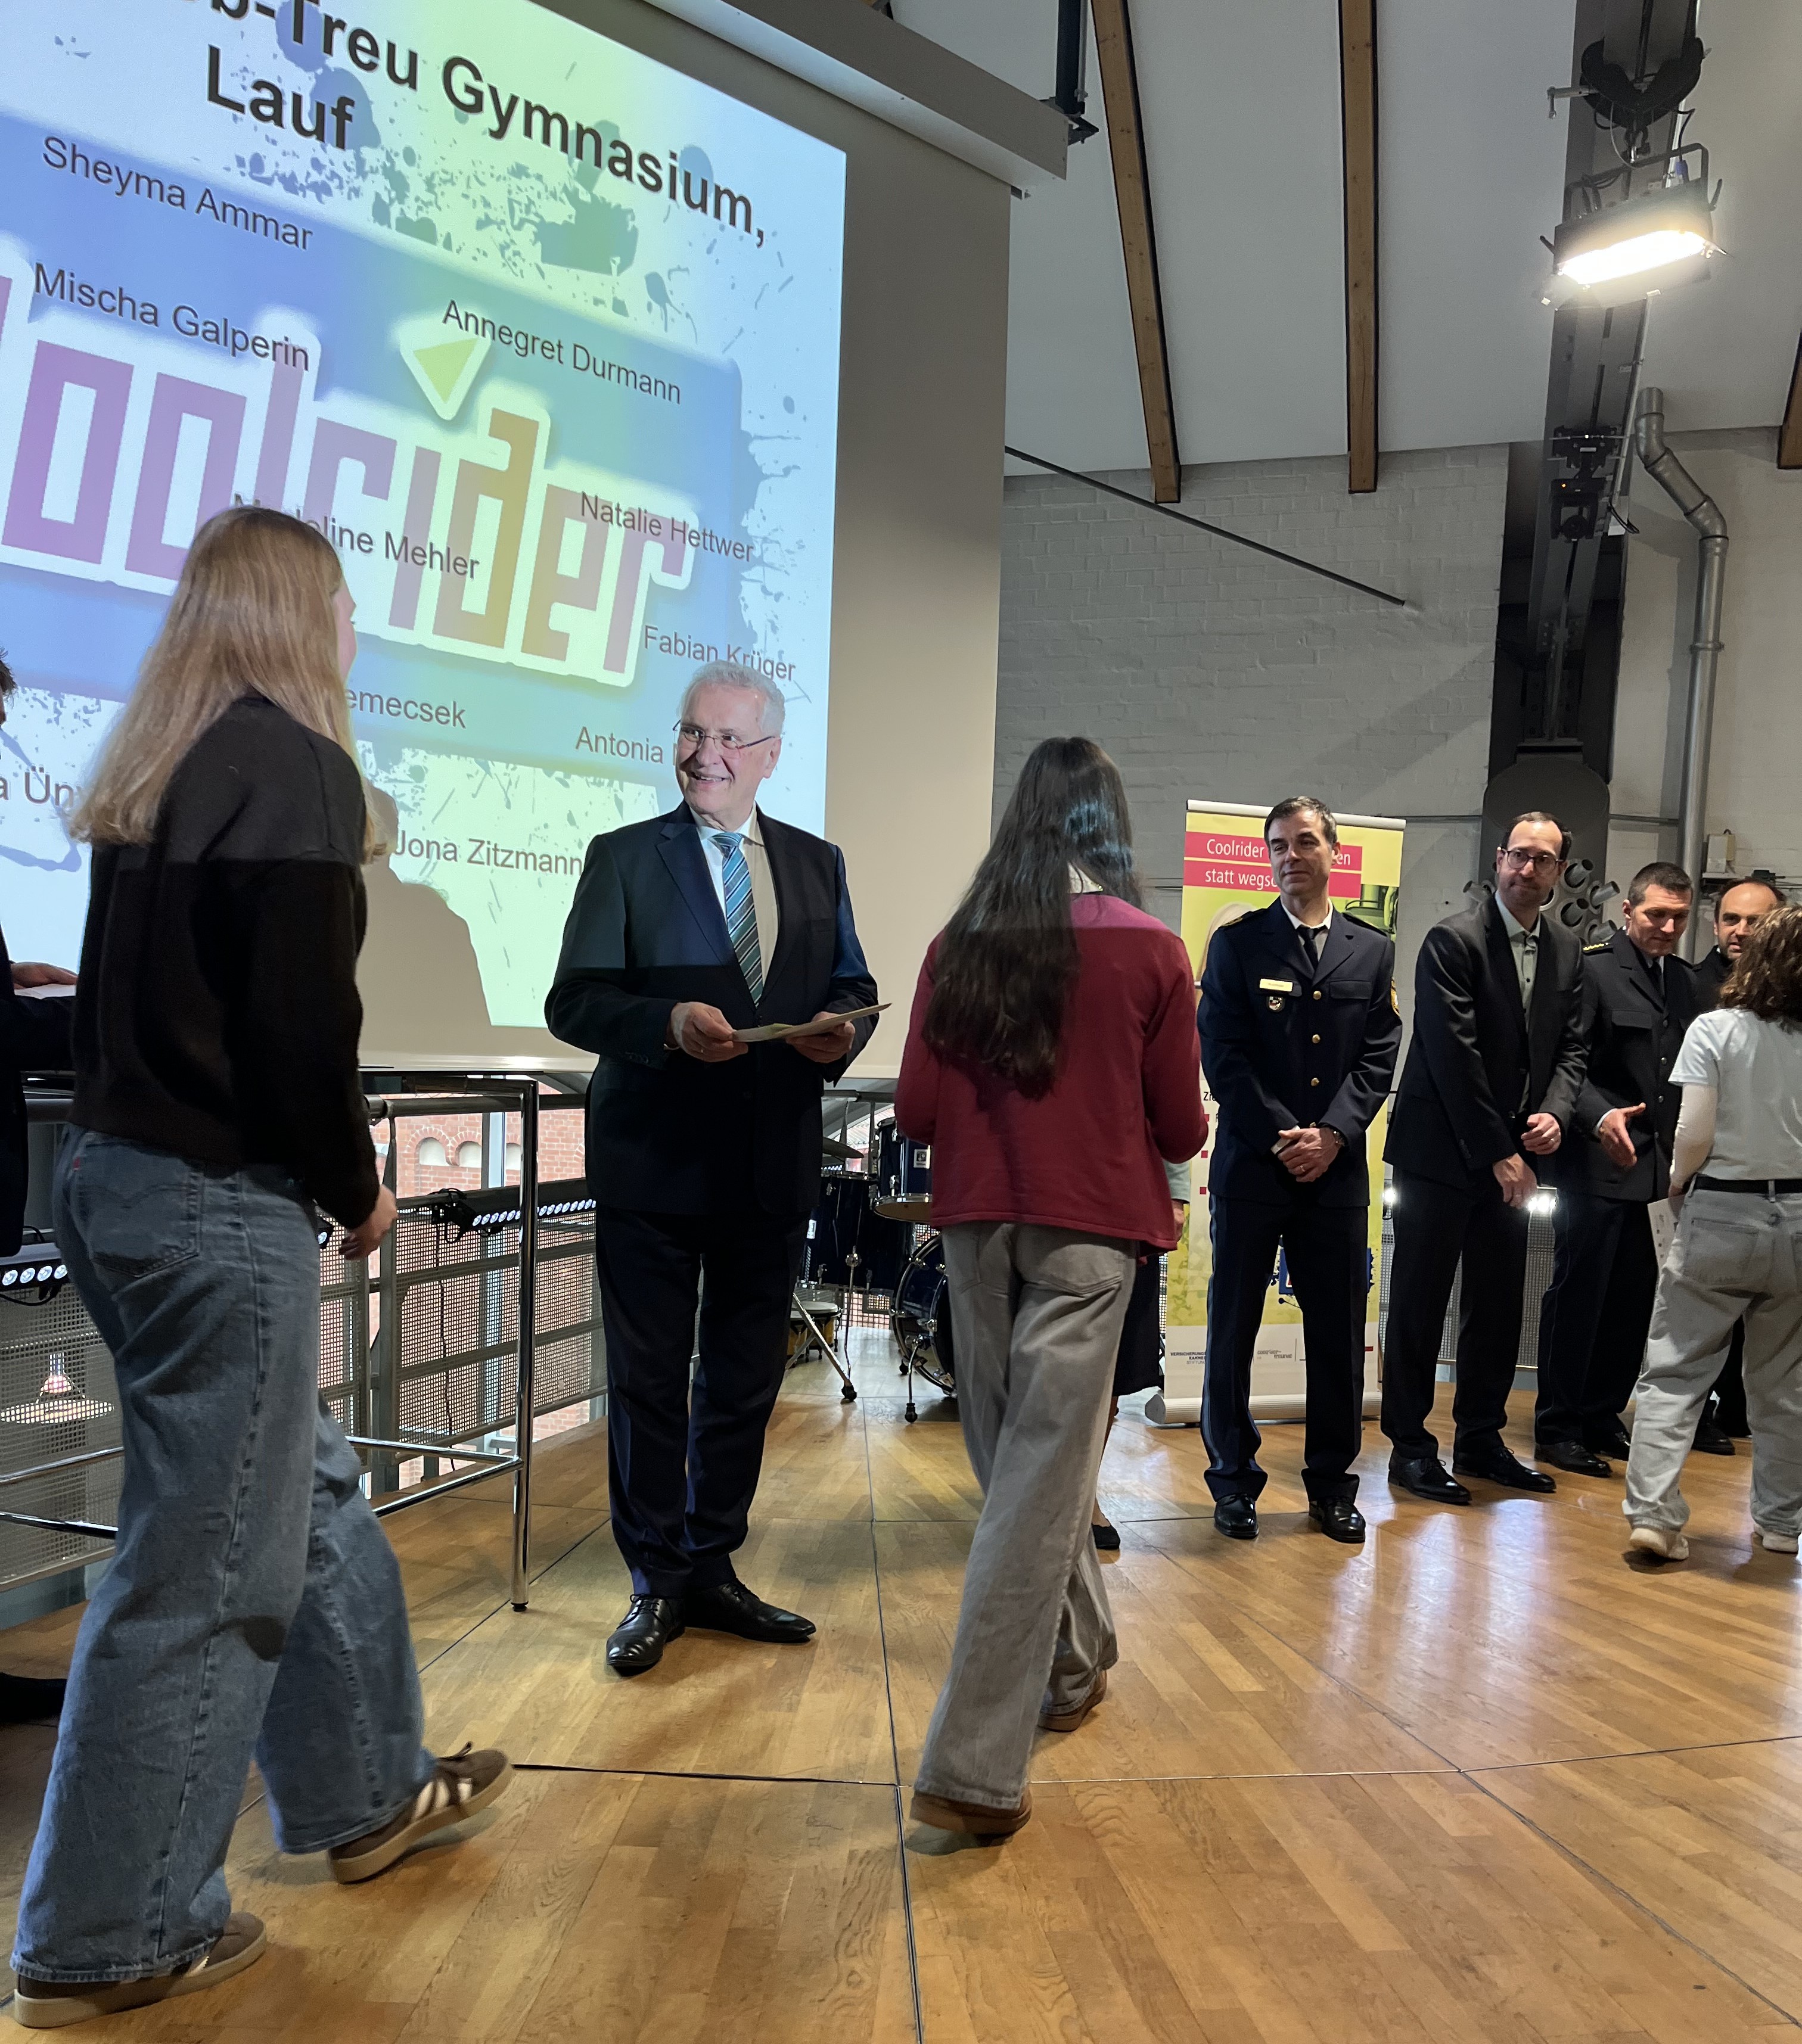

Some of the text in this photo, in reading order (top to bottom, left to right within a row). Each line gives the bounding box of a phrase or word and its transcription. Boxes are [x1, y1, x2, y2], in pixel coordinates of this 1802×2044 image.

[207, 44, 355, 150] Lauf
[442, 56, 765, 248] Gymnasium,
[42, 136, 313, 250] Sheyma Ammar
[35, 262, 309, 371] Mischa Galperin
[442, 300, 681, 405] Annegret Durmann
[0, 275, 689, 674] oolrider
[385, 531, 480, 579] Mehler
[580, 492, 754, 562] Natalie Hettwer
[644, 625, 796, 681] Fabian Krüger
[345, 688, 466, 729] emecsek
[576, 726, 663, 764] Antonia
[395, 830, 582, 876] Jona Zitzmann
[1205, 869, 1278, 891] statt wegsc
[1206, 839, 1265, 858] Coolrider
